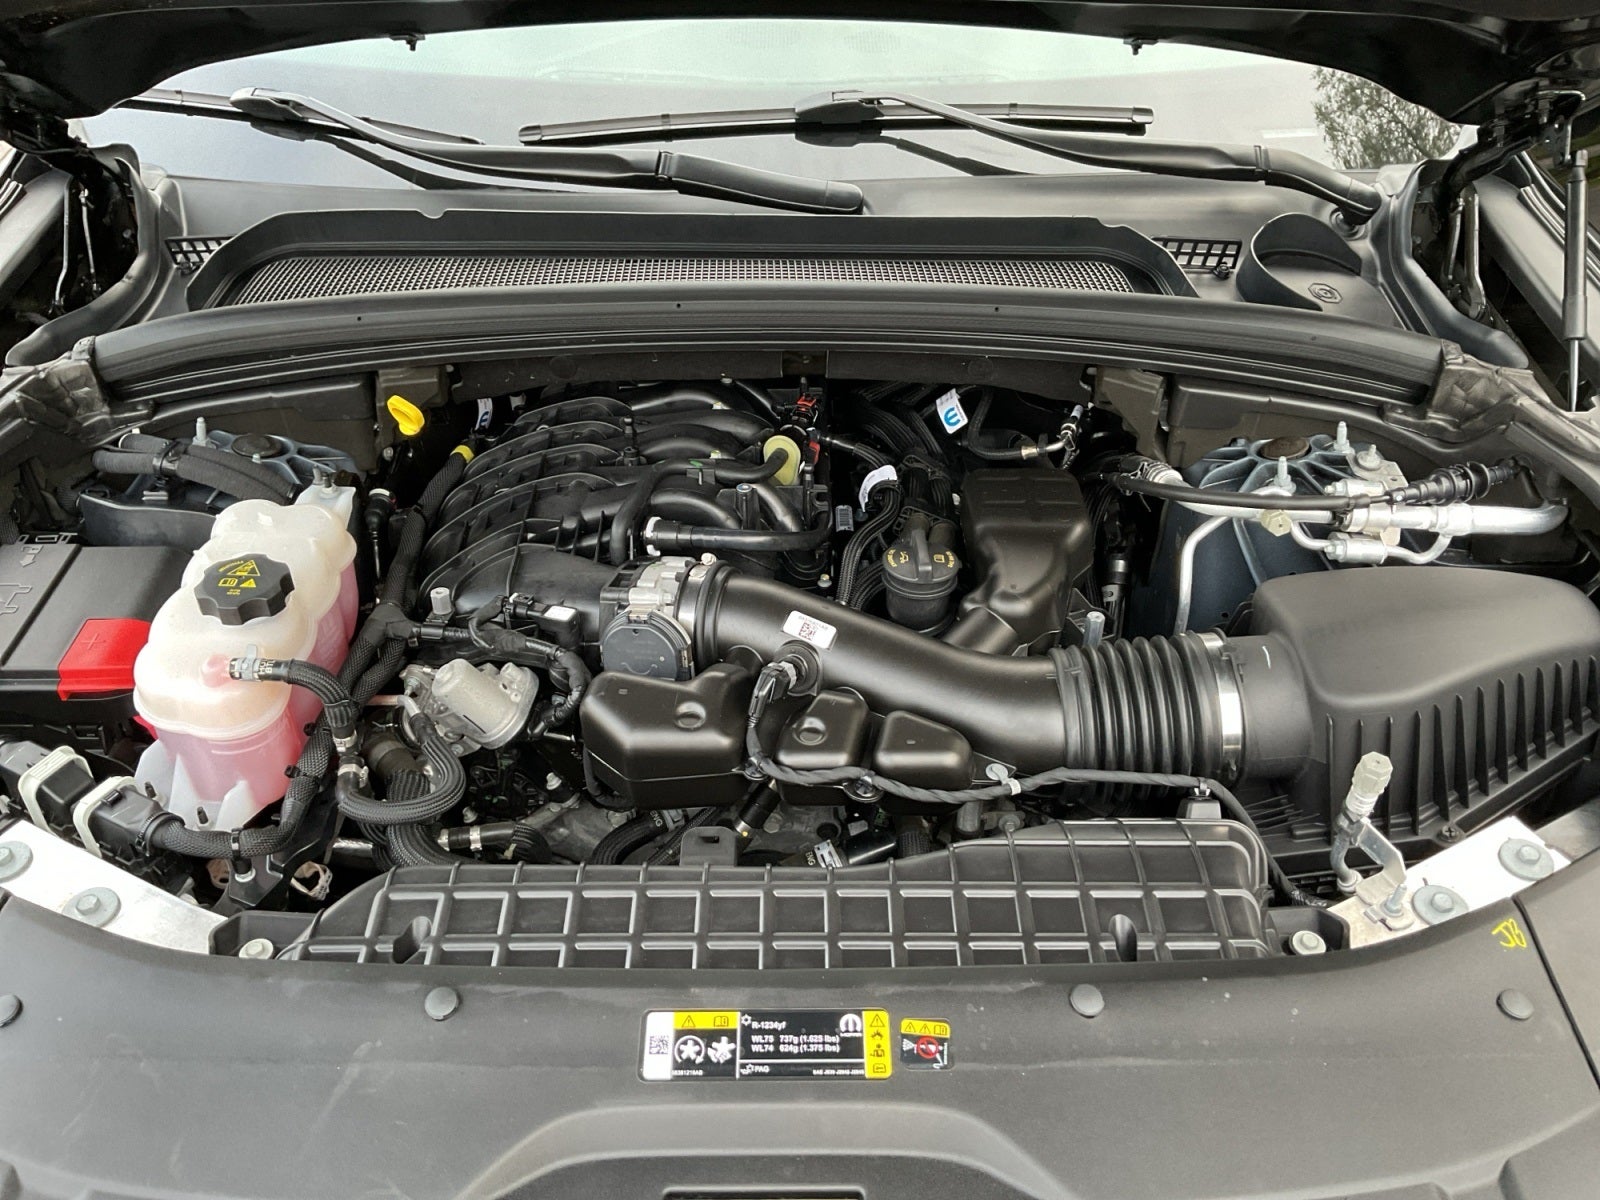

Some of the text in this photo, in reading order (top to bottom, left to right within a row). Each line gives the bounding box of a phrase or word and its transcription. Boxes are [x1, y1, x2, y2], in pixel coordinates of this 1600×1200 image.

[650, 810, 662, 826] ENG
[805, 852, 816, 866] ENG
[751, 1021, 786, 1030] R-1234yf
[751, 1034, 840, 1044] WL75 737g (1.625 lbs)
[751, 1044, 840, 1053] WL74 624g (1.375 lbs)
[754, 1065, 770, 1073] PAG
